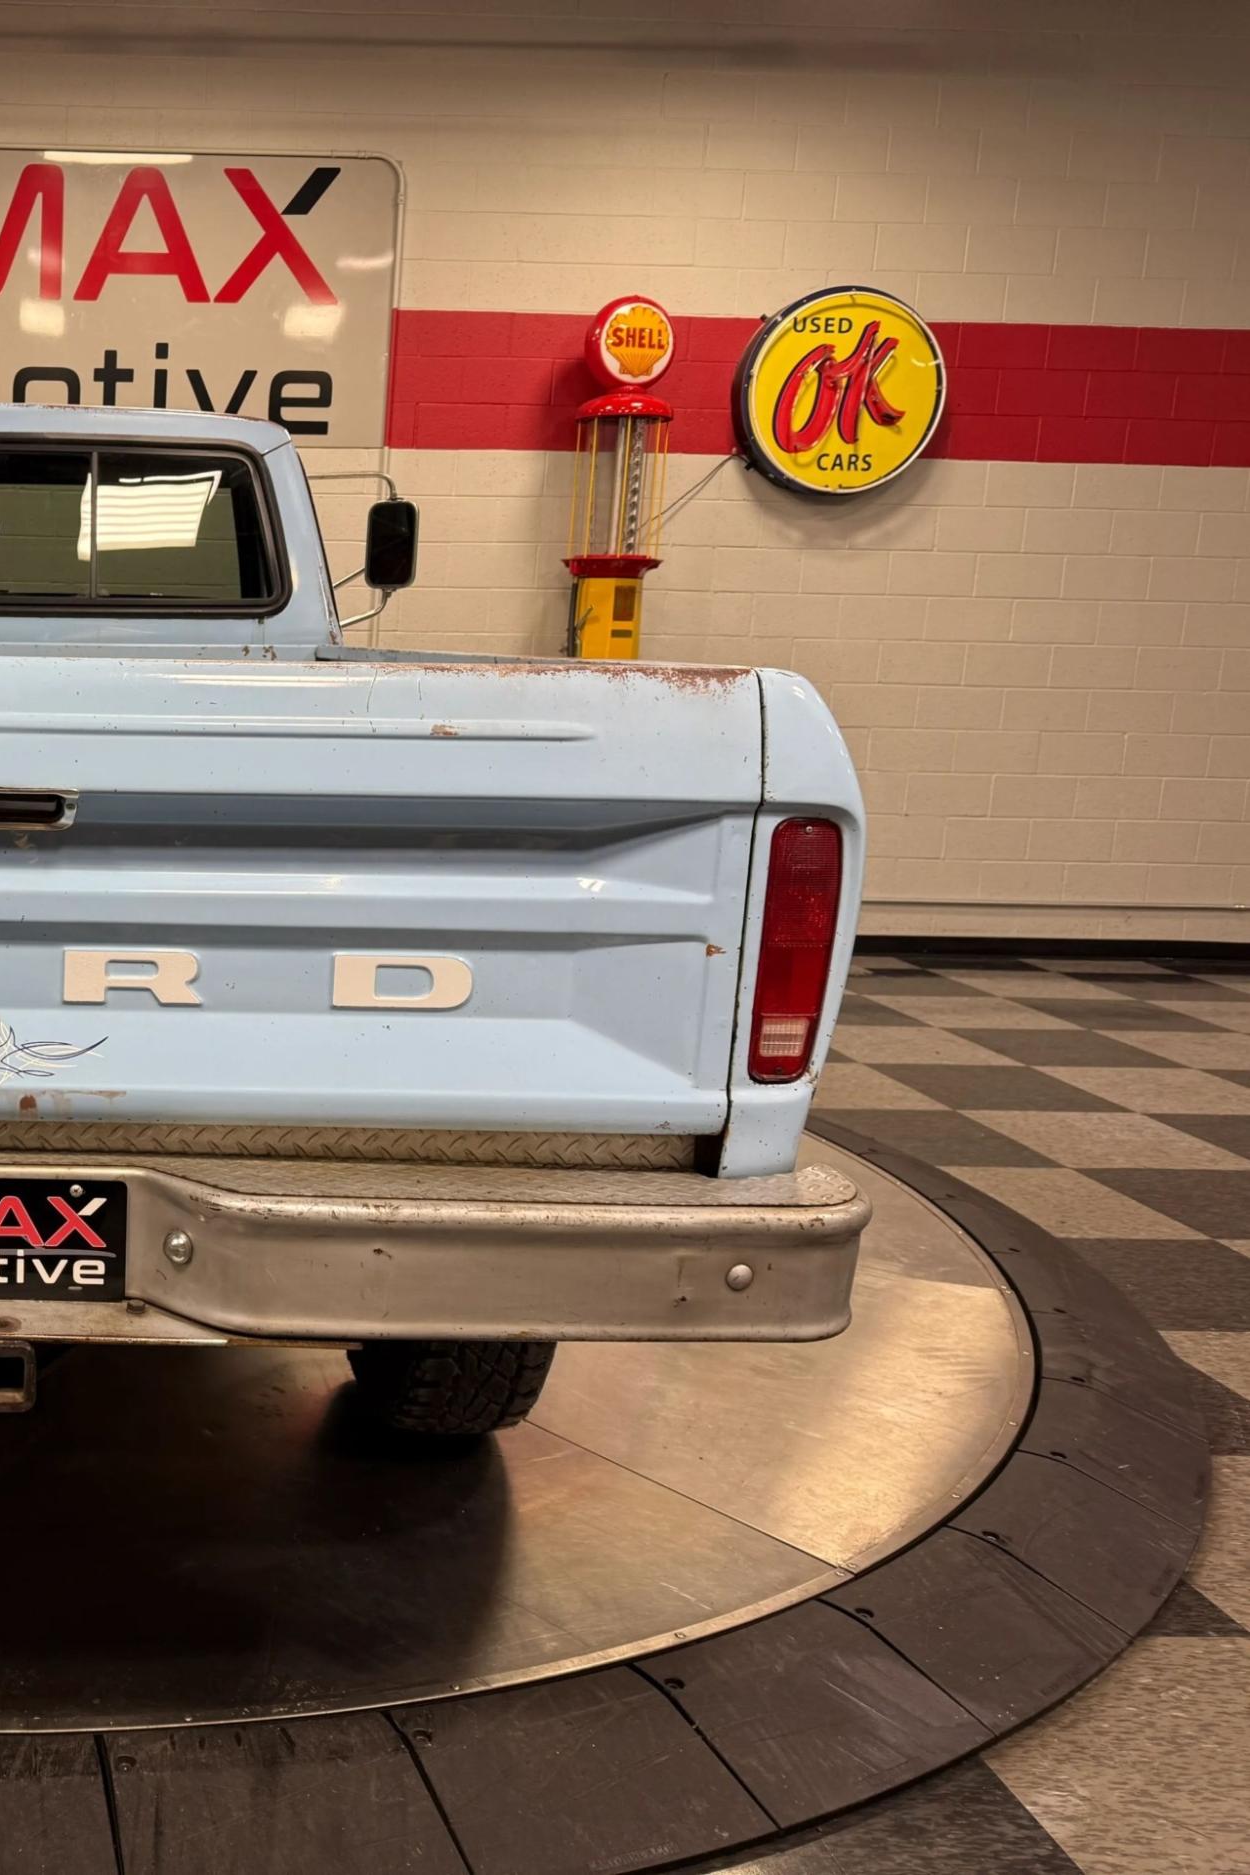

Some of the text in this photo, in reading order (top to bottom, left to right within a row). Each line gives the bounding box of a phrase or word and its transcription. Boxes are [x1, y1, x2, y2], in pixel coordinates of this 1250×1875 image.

[793, 317, 853, 335] USED
[611, 326, 665, 350] SHELL
[772, 320, 905, 453] OK
[816, 453, 872, 472] CARS
